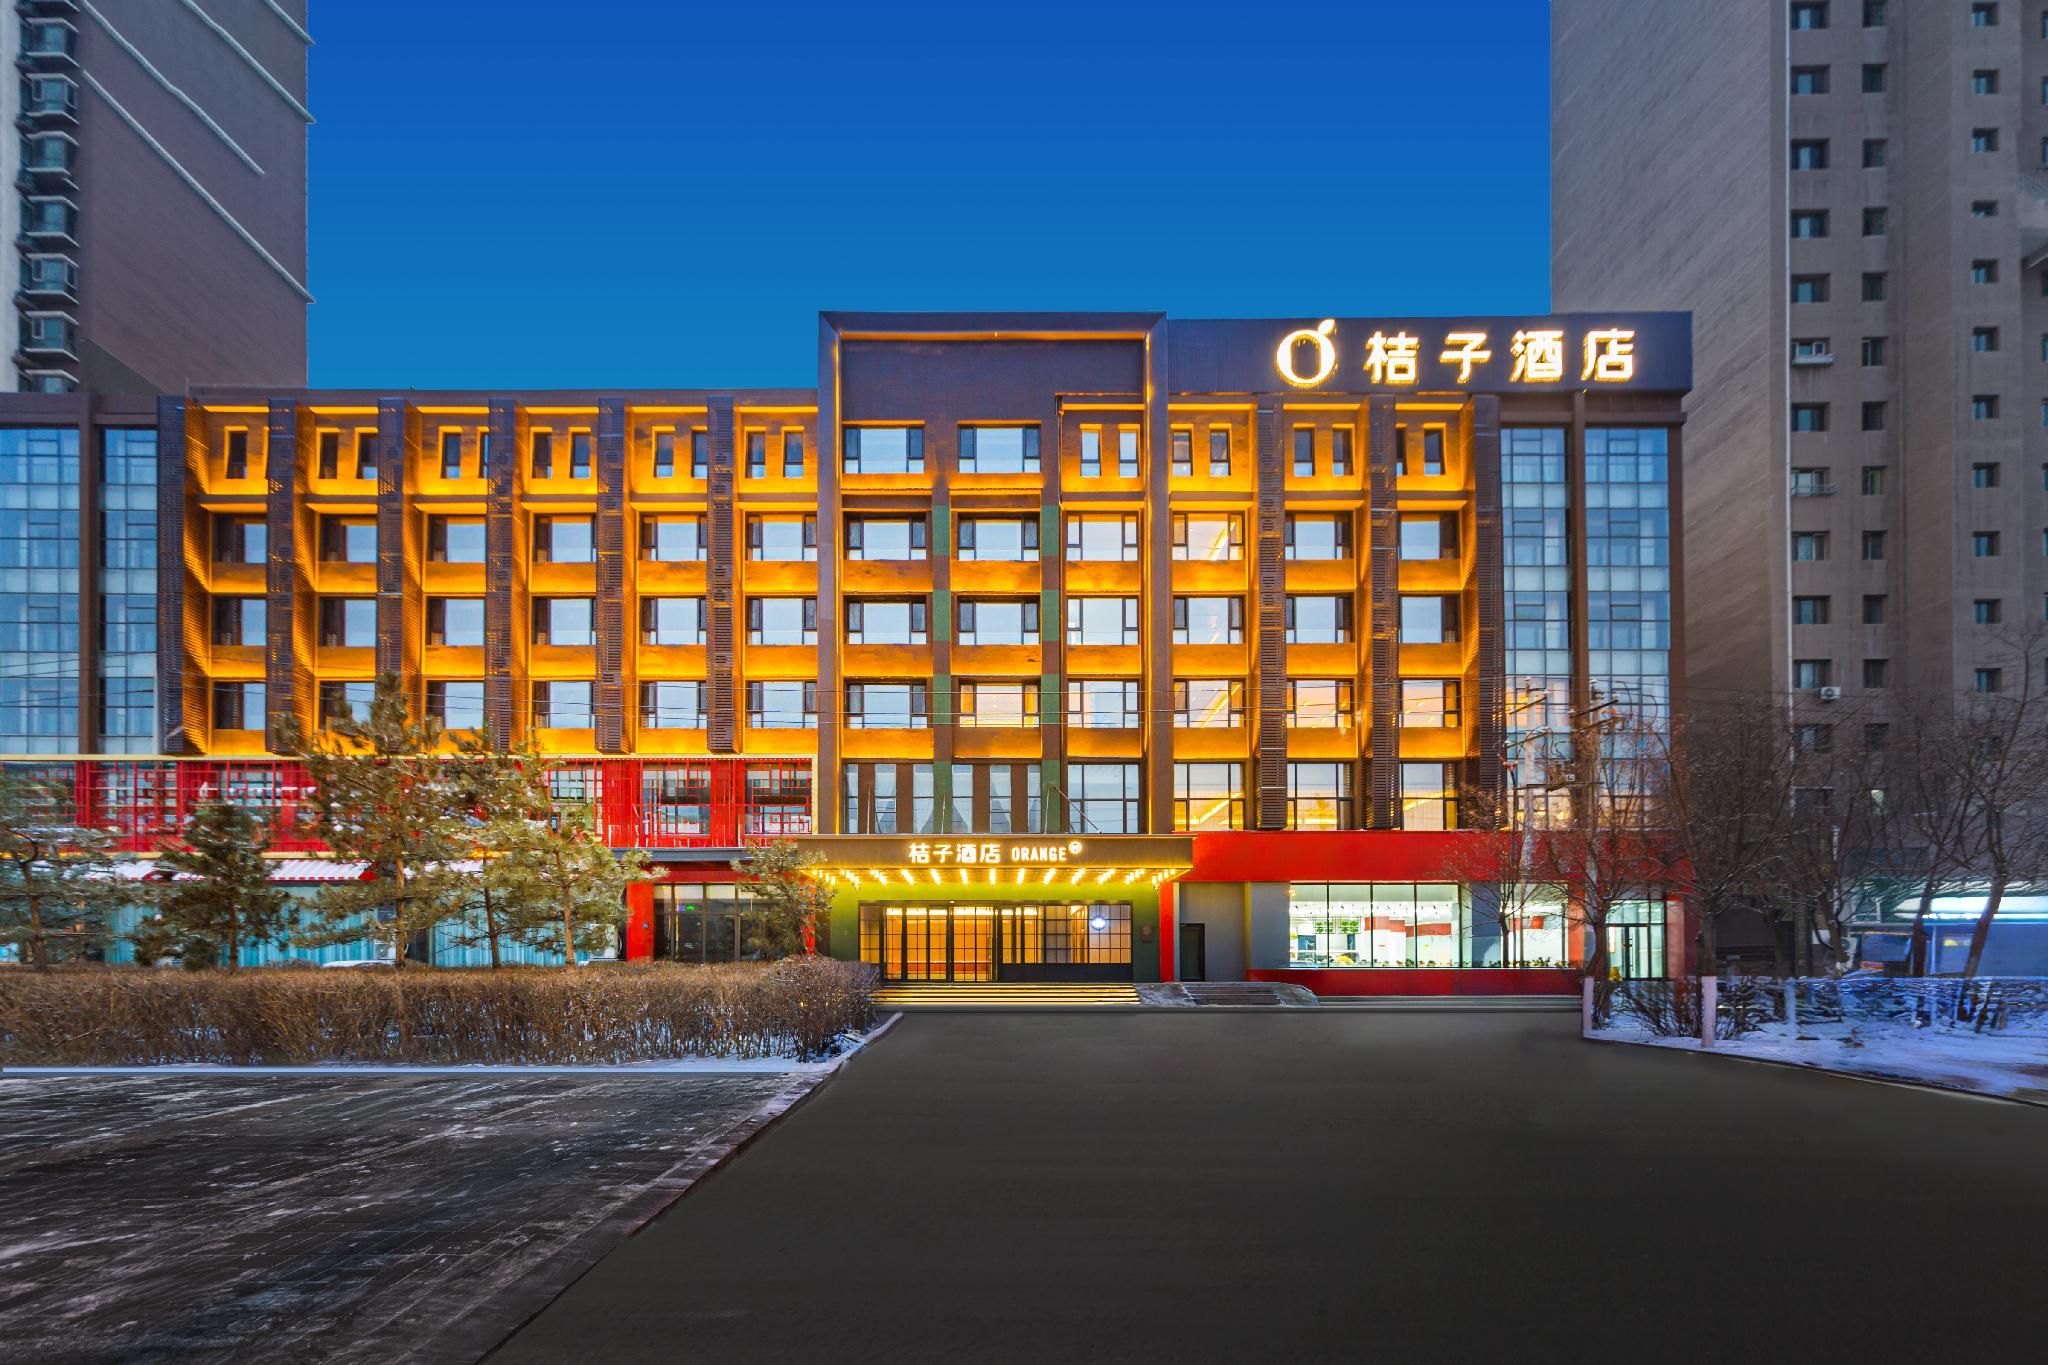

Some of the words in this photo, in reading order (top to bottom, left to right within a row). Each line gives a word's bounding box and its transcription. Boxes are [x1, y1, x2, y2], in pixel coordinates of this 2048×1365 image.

[1365, 328, 1635, 384] 桔子酒店
[908, 843, 1001, 864] 桔子酒店
[1011, 846, 1068, 862] ORANGE
